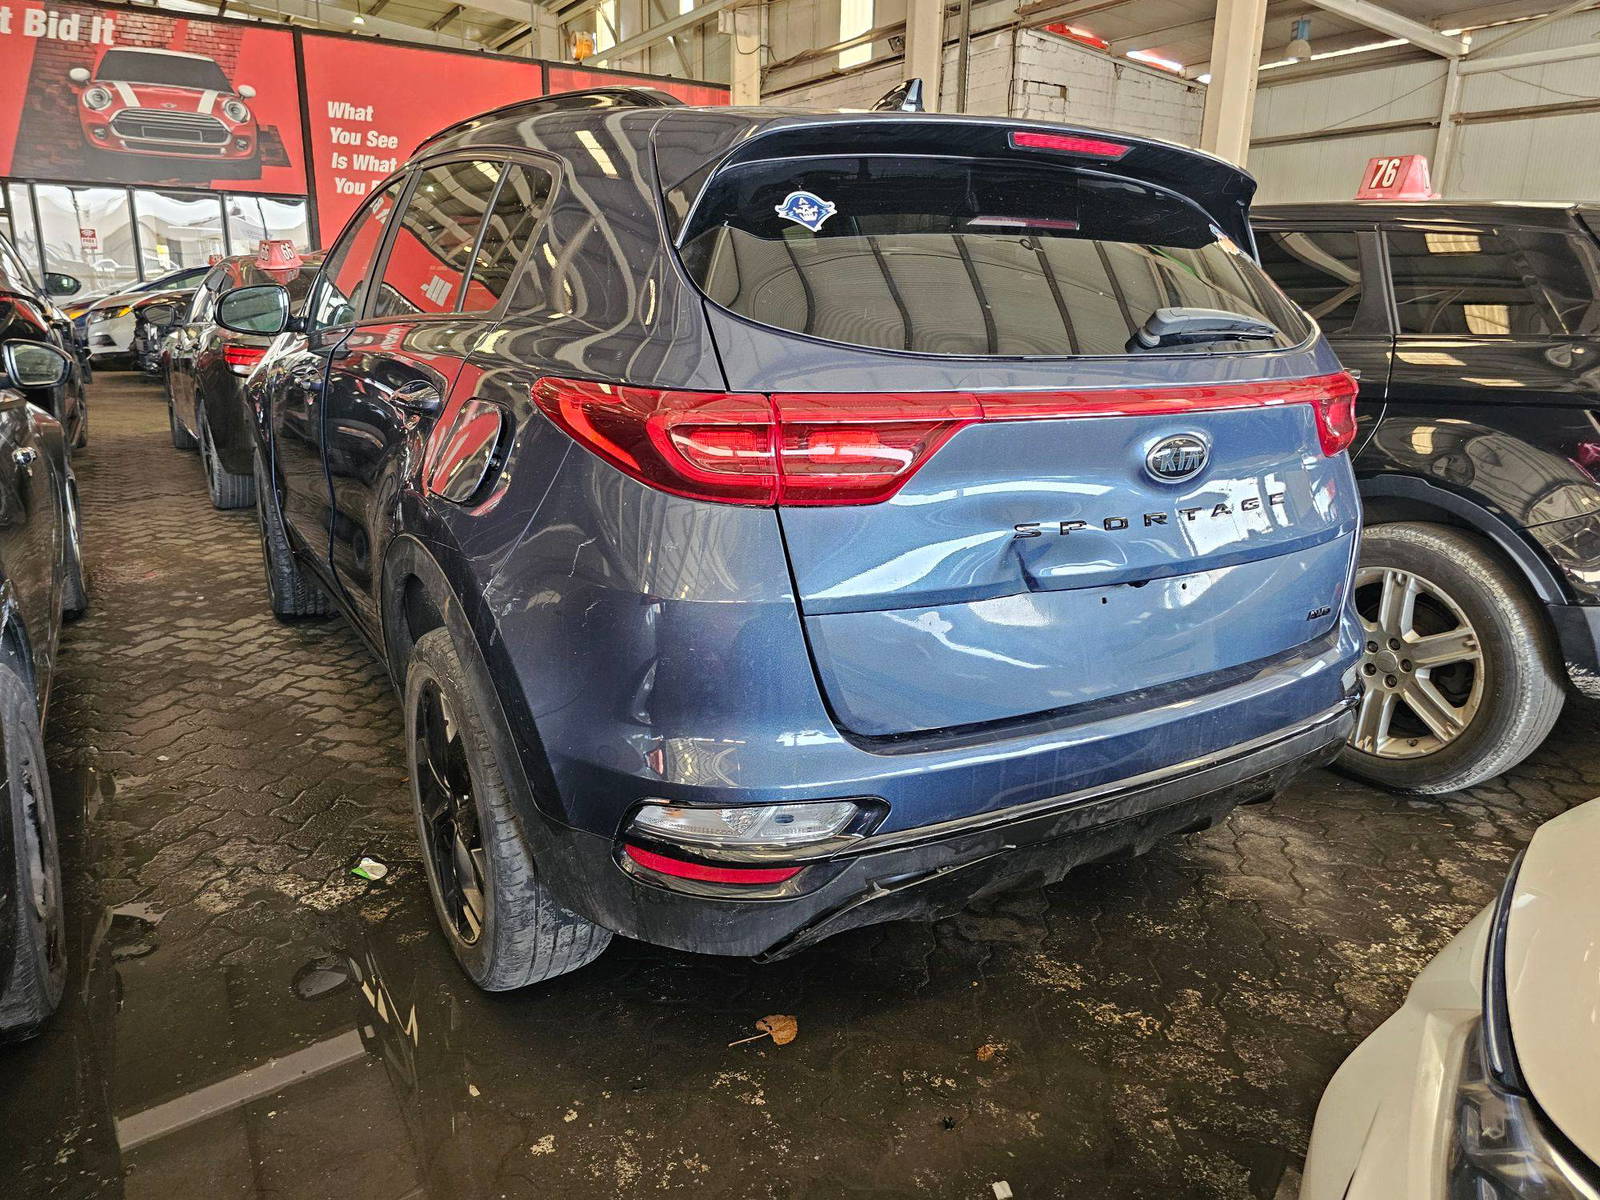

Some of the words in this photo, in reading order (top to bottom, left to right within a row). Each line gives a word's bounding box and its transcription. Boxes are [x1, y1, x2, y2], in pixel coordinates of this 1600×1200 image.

[24, 8, 81, 41] Bid
[91, 16, 116, 45] It
[327, 101, 374, 121] What
[330, 127, 362, 145] You
[366, 130, 398, 149] See
[331, 152, 348, 169] Is
[353, 154, 398, 173] What
[1369, 158, 1401, 189] 76
[335, 177, 366, 195] You
[280, 242, 295, 261] 66
[1159, 447, 1202, 472] KIA
[1013, 492, 1286, 540] SPORTAGE
